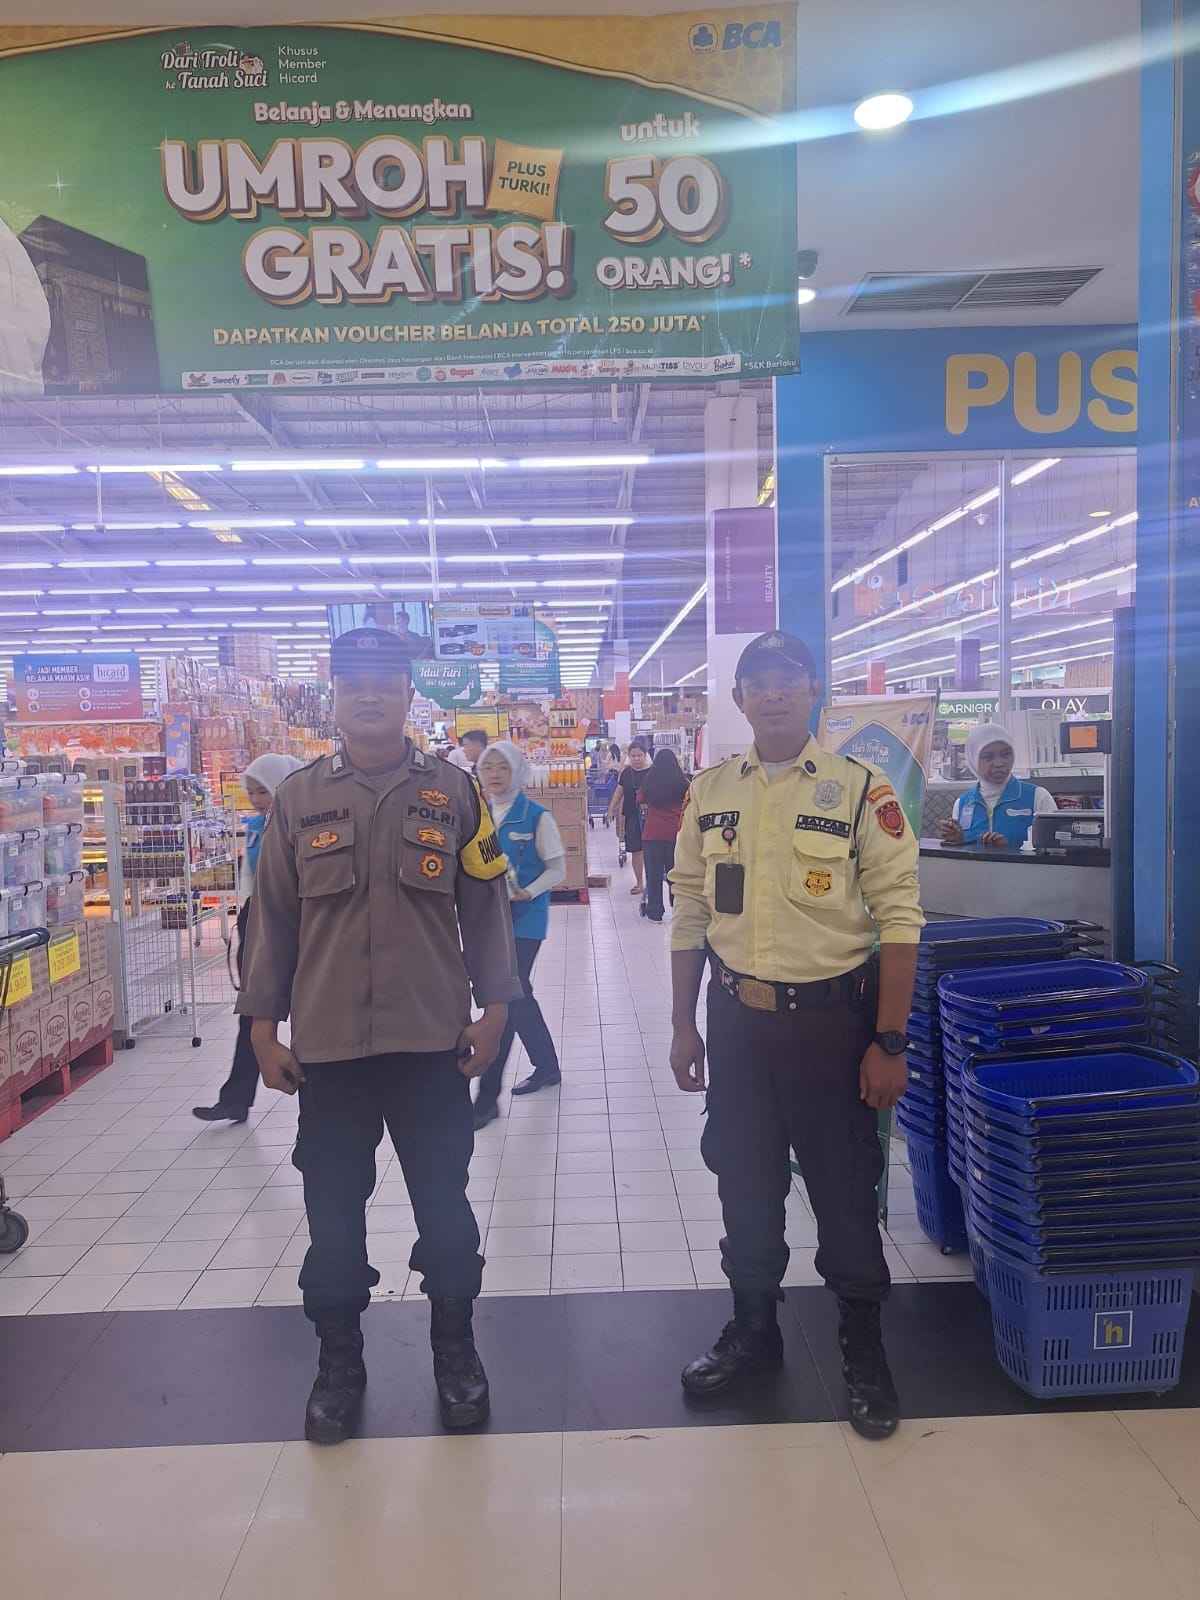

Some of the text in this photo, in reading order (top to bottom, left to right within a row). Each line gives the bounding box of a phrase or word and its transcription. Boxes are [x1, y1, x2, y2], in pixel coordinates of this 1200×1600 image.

[722, 21, 781, 49] BCA
[161, 49, 239, 69] Dari Troli
[278, 46, 319, 56] Khusus
[278, 59, 327, 69] Member
[177, 71, 229, 89] Tanah
[234, 70, 268, 88] Suci
[279, 72, 318, 84] Hicard
[253, 98, 472, 126] Belanja & Menangkan
[620, 112, 700, 142] untuk
[161, 136, 489, 218] UMROH
[507, 160, 547, 177] PLUS
[498, 176, 551, 196] TURKI!
[603, 155, 723, 240] 50
[244, 223, 569, 301] GRATIS!
[213, 326, 329, 345] DAPATKAN
[334, 325, 436, 343] VOUCHER
[440, 320, 534, 342] BELANJA
[537, 316, 605, 336] TOTAL
[607, 316, 646, 334] 250
[407, 805, 456, 827] POLRI
